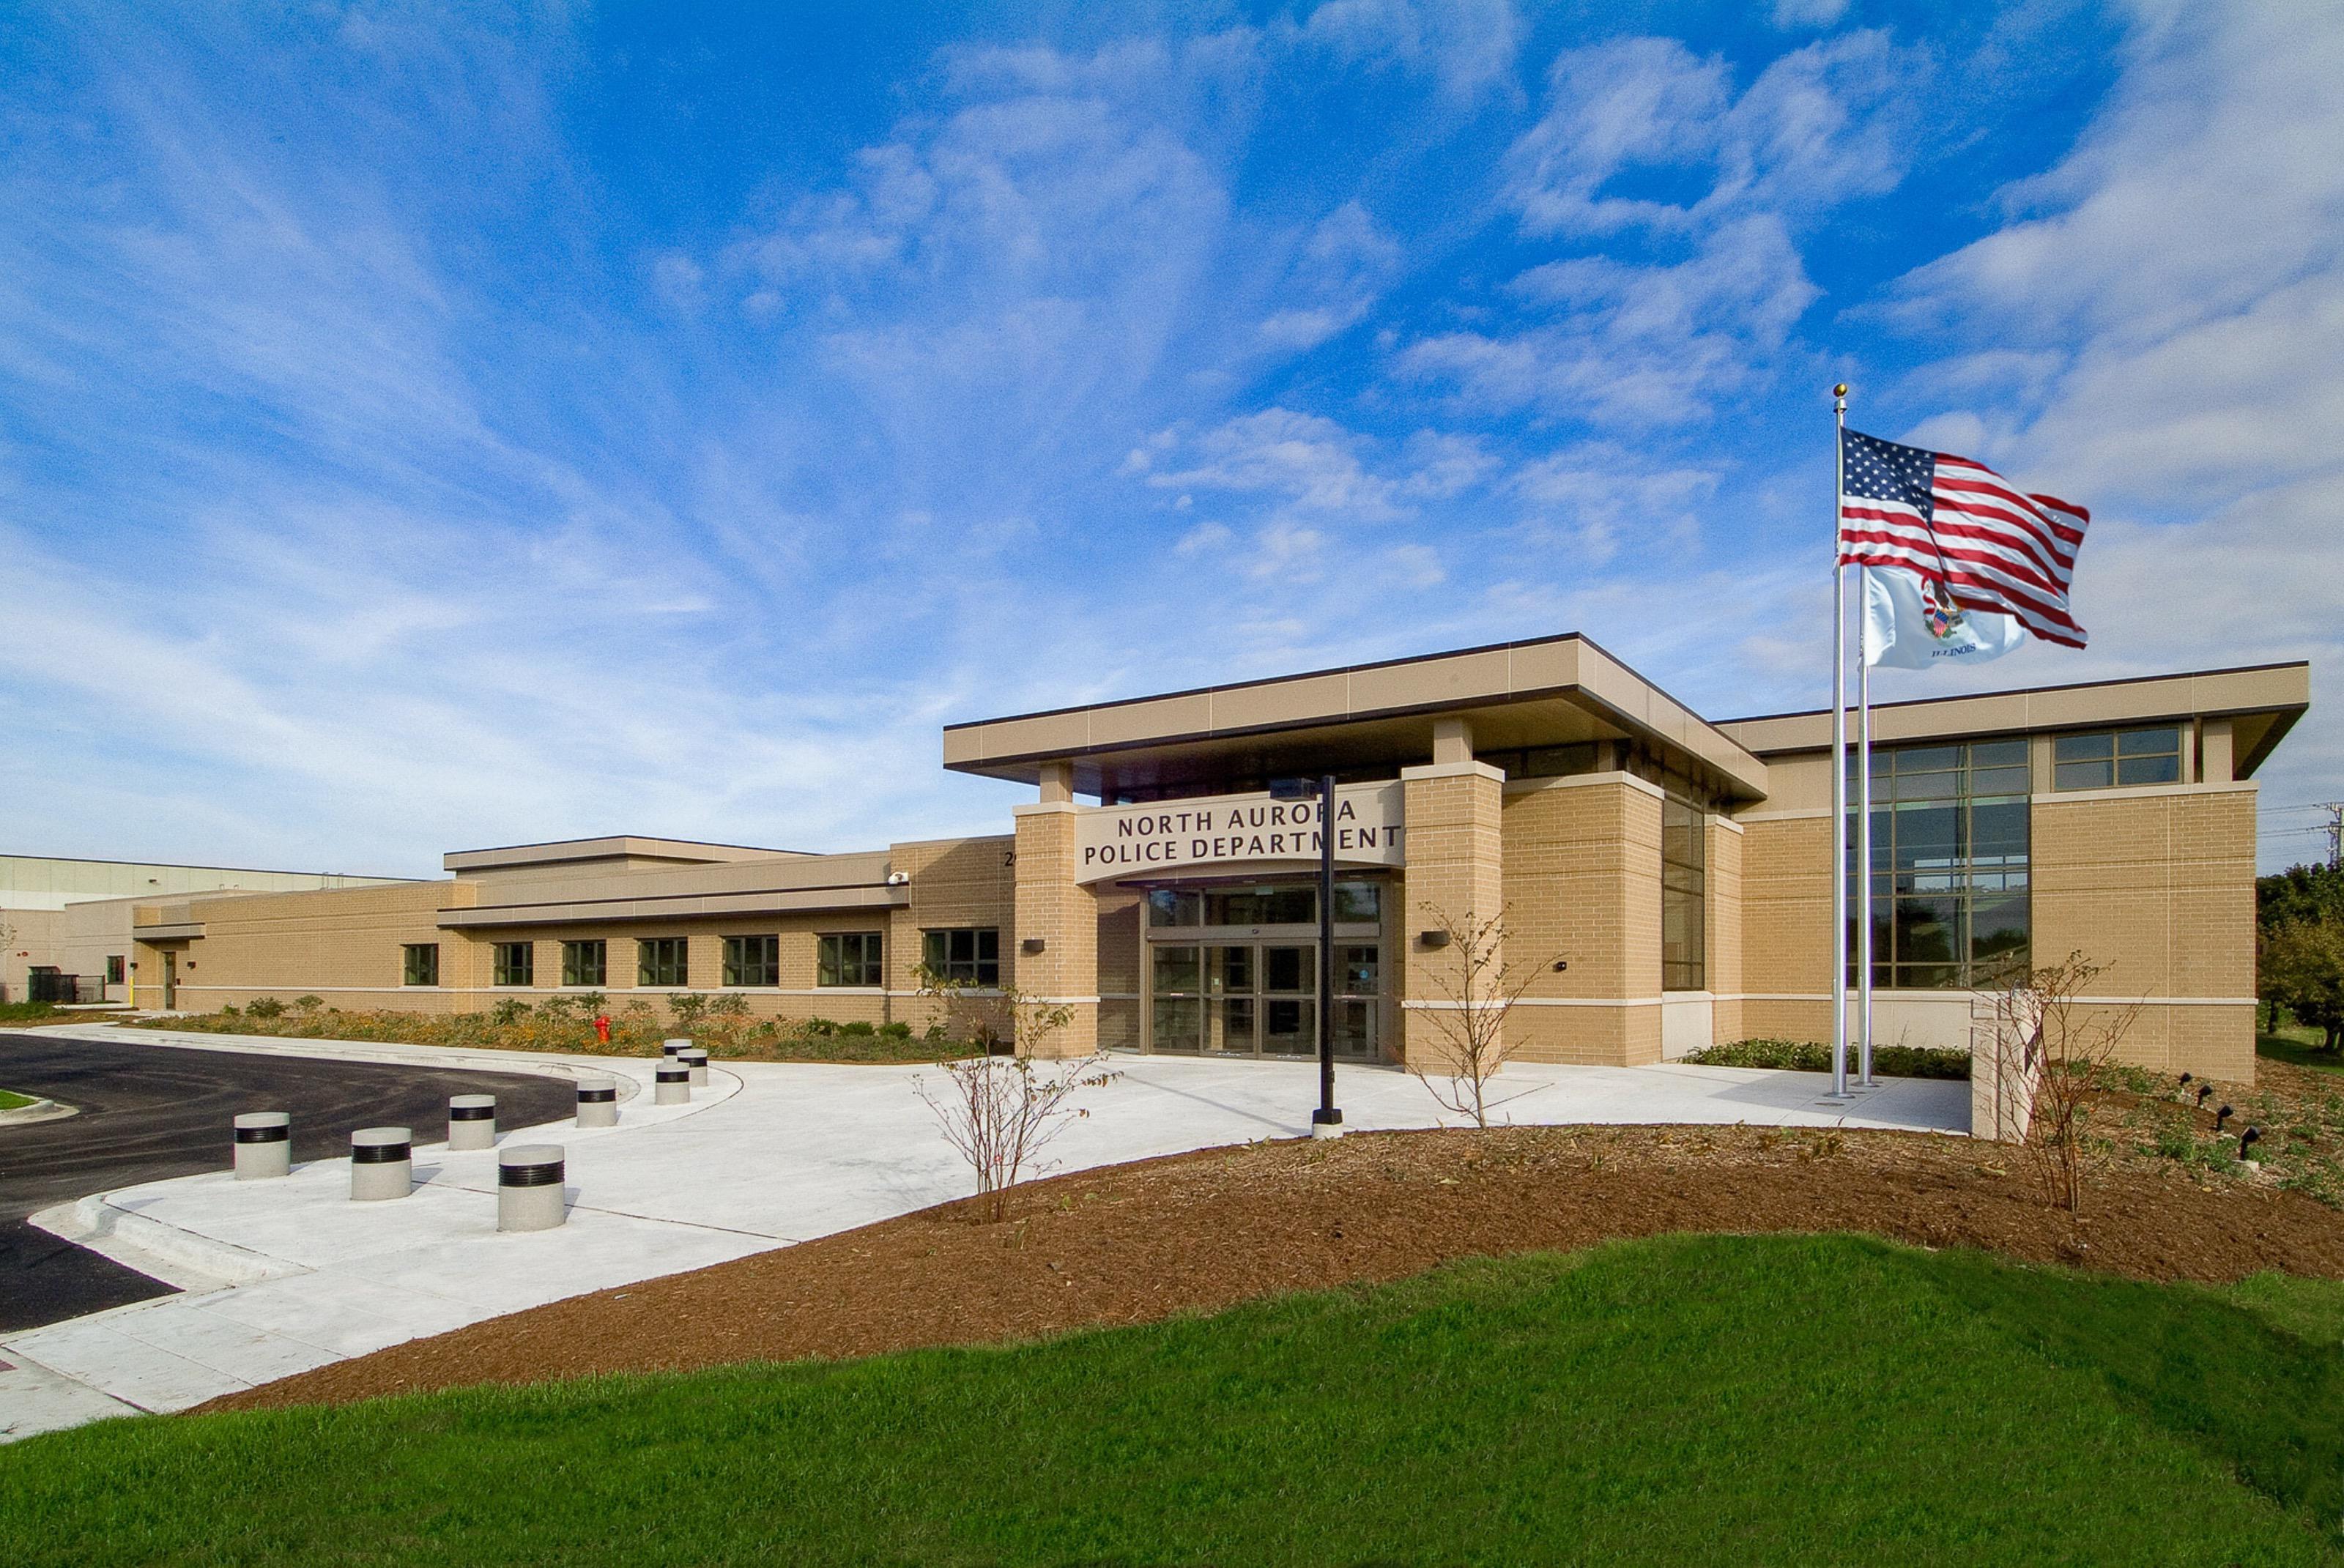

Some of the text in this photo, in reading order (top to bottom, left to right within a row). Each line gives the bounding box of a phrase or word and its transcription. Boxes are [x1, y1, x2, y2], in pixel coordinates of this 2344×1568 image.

[1119, 811, 1211, 837] NORTH
[1004, 852, 1016, 866] 2
[1085, 841, 1177, 865] POLICE
